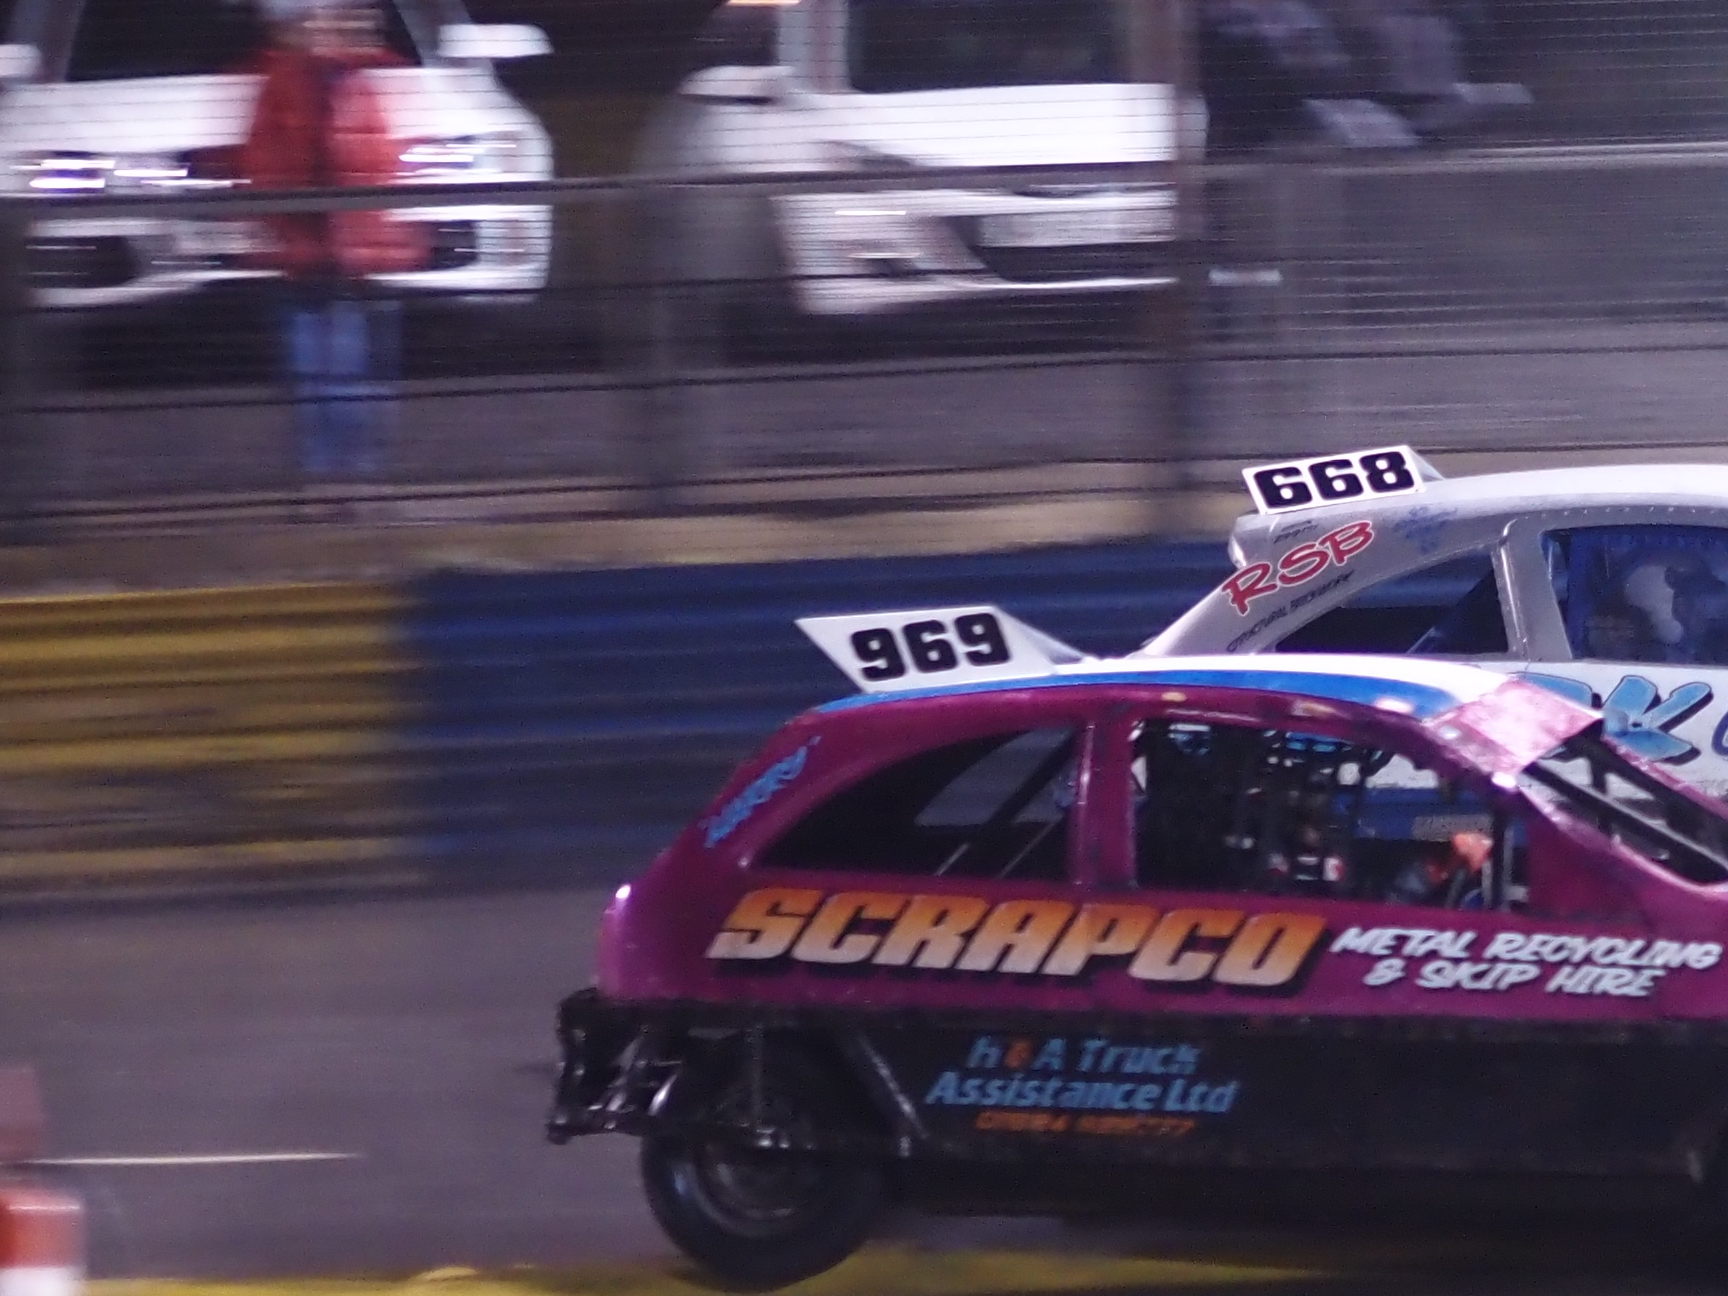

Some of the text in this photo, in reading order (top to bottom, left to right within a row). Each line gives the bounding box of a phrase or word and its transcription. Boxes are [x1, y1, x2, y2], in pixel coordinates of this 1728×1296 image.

[1252, 451, 1415, 510] 668
[1221, 519, 1375, 616] RSB
[851, 612, 1013, 683] 969
[704, 887, 1328, 989] SCRAPCO
[1329, 925, 1723, 971] METAL RECYCLING
[1361, 959, 1666, 999] & SKIP HIRE
[1030, 1037, 1067, 1071] A
[924, 1070, 1241, 1114] Assistance Ltd
